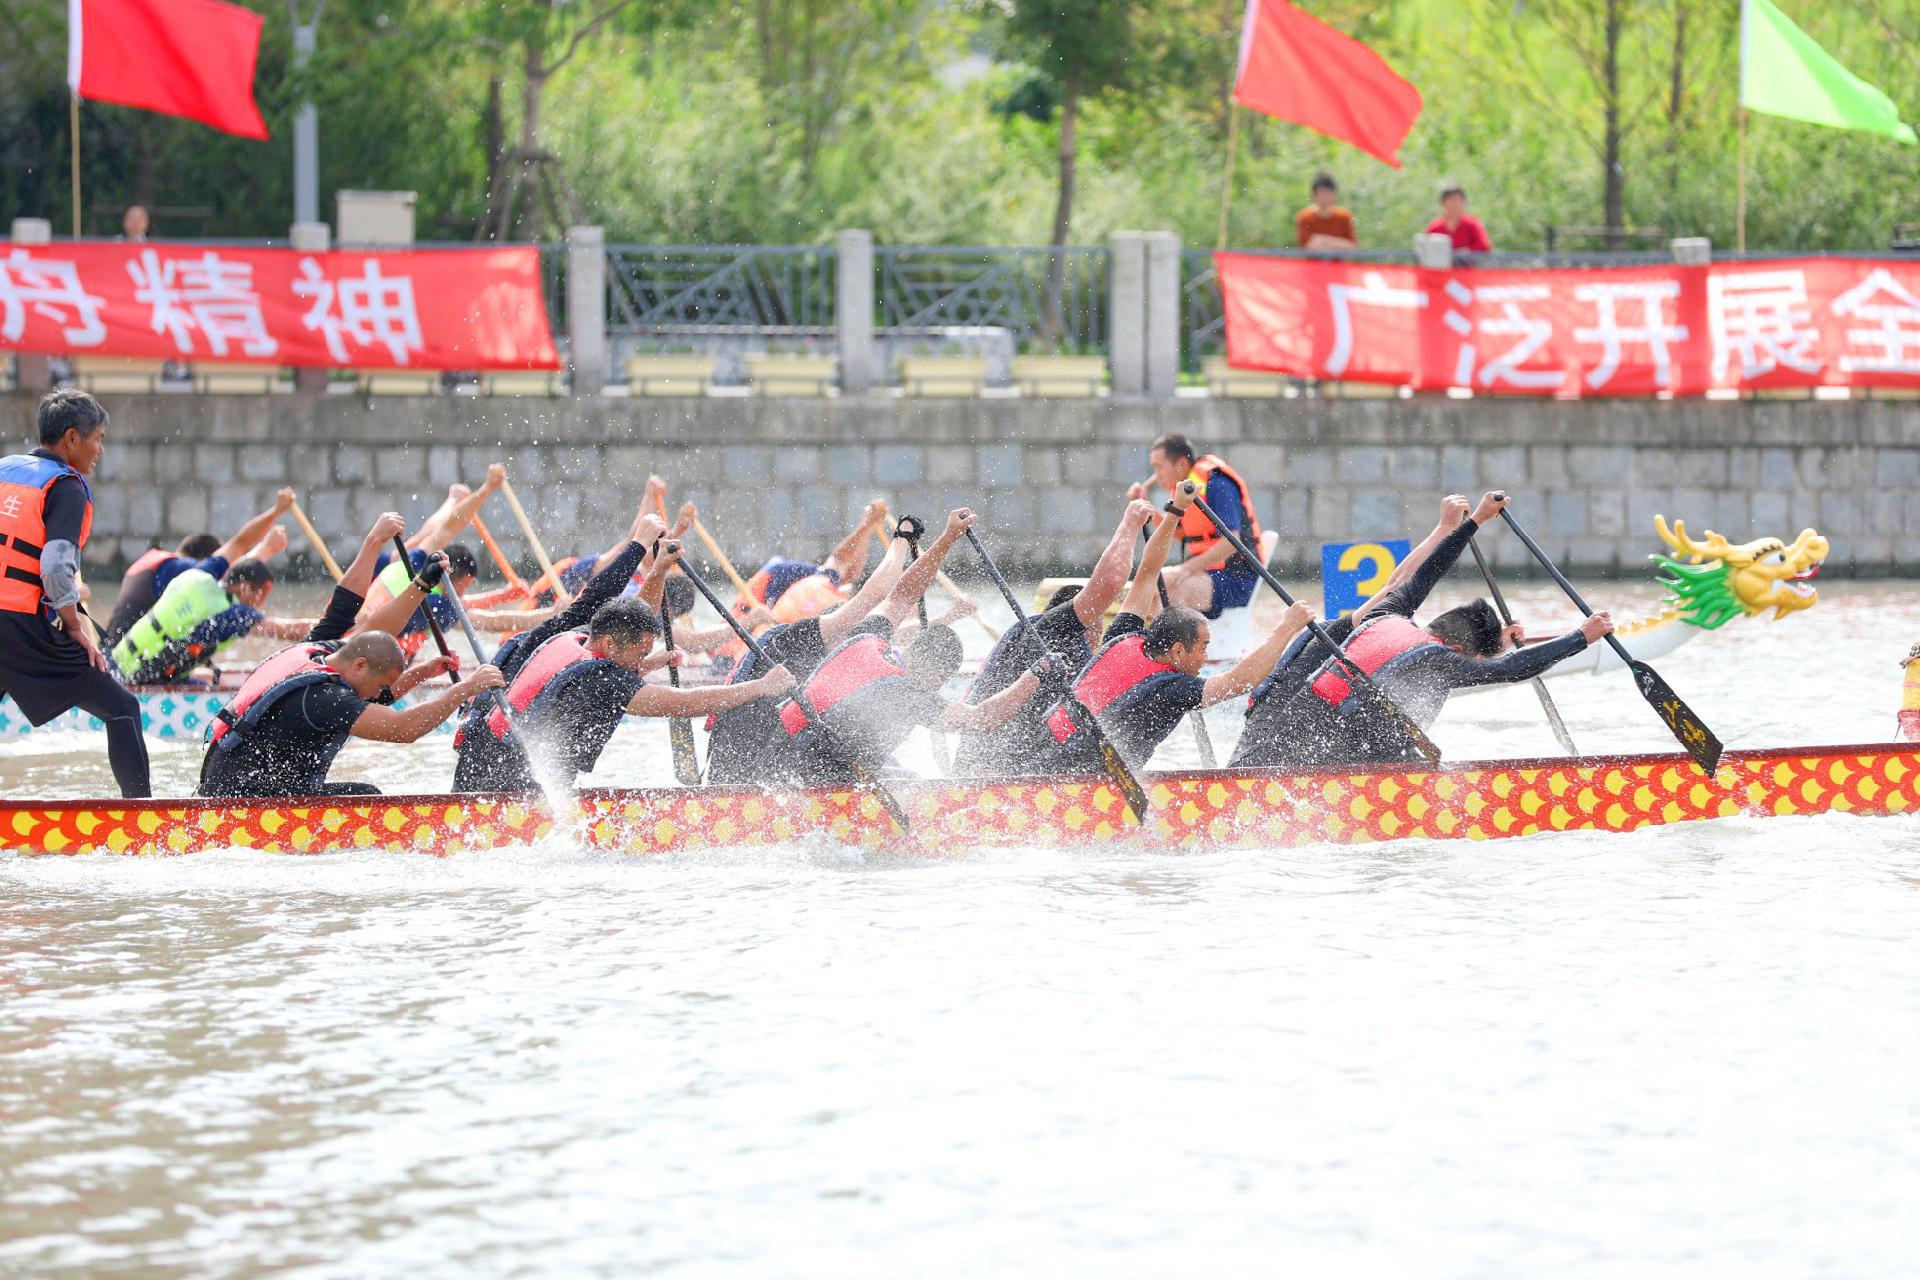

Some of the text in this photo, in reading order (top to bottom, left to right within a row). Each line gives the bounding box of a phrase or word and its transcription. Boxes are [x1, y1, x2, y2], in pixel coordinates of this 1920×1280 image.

[0, 248, 425, 365] 舟精神
[1326, 267, 1920, 388] 广泛开展全
